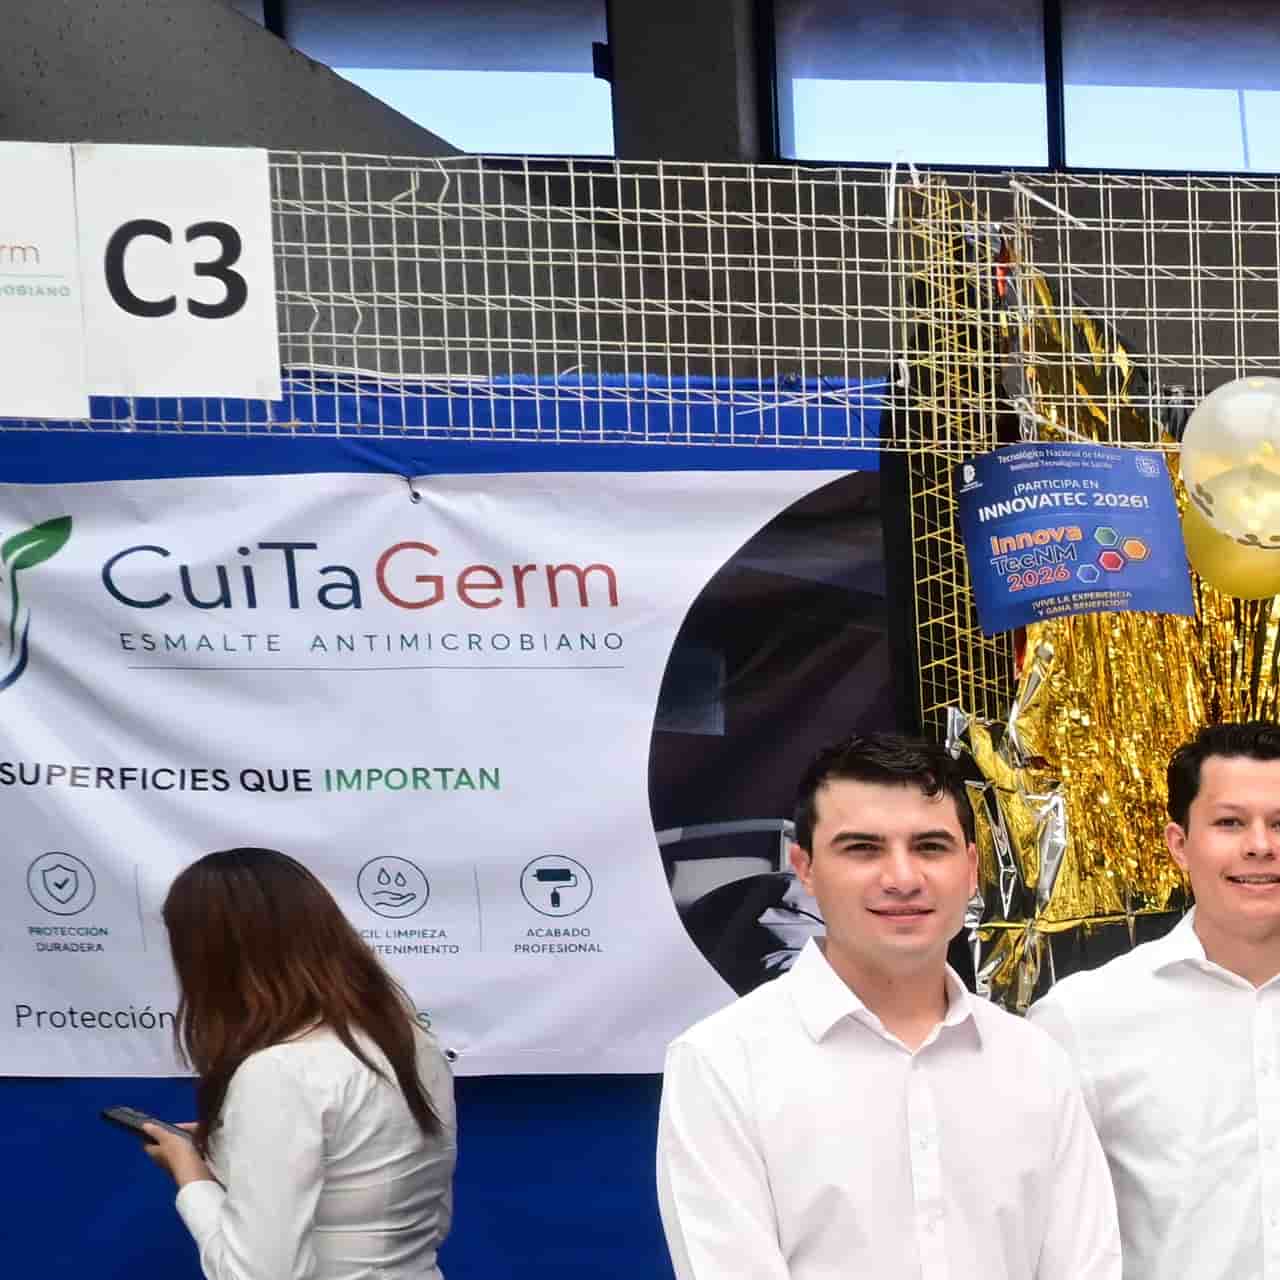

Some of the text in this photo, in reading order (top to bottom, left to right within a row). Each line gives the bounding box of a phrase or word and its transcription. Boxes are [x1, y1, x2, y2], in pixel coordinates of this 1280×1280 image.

[104, 219, 249, 319] C3
[1013, 479, 1099, 497] ¡PARTICIPA EN
[978, 491, 1151, 522] INNOVATEC 2026!
[990, 525, 1084, 557] Innova
[990, 543, 1078, 577] TecNM
[101, 540, 620, 611] CuiTaGerm
[1007, 564, 1072, 593] 2026
[119, 631, 625, 653] ESMALTE ANTIMICROBIANO
[0, 761, 501, 793] SUPERFICIES QUE IMPORTAN
[385, 928, 448, 939] LIMPIEZA
[526, 927, 592, 938] ACABADO
[36, 942, 105, 953] DURADERA
[373, 944, 461, 954] TENIMIENTO
[513, 943, 604, 954] PROFESIONAL
[15, 1004, 177, 1029] Protección
